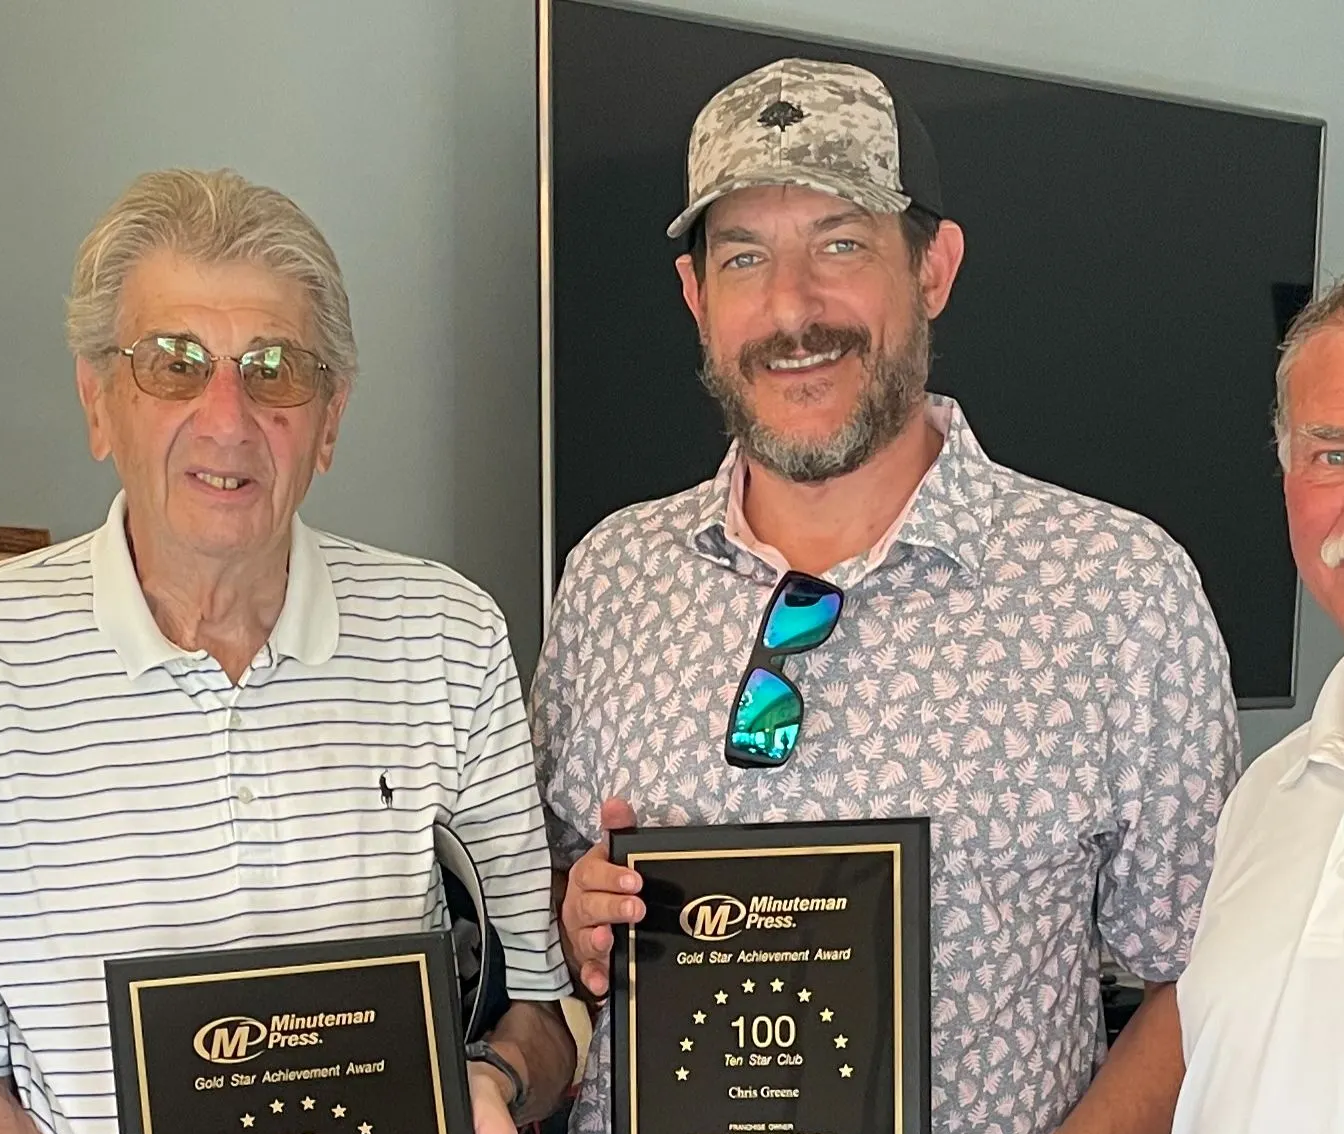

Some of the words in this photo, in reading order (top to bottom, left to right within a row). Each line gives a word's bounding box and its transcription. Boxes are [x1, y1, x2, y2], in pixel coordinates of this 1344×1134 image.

[750, 896, 847, 912] Minuteman
[677, 952, 704, 964] Gold
[709, 951, 733, 963] Star
[737, 950, 809, 962] Achievement
[814, 948, 851, 960] Award
[270, 1010, 375, 1030] Minuteman
[732, 1016, 795, 1048] 100
[725, 1054, 743, 1066] Ten
[749, 1054, 772, 1066] Star
[777, 1054, 803, 1065] Club
[195, 1076, 224, 1090] Gold
[231, 1074, 256, 1086] Star
[262, 1065, 340, 1083] Achievement
[346, 1060, 384, 1075] Award
[729, 1087, 757, 1098] Chris
[761, 1086, 799, 1097] Greene
